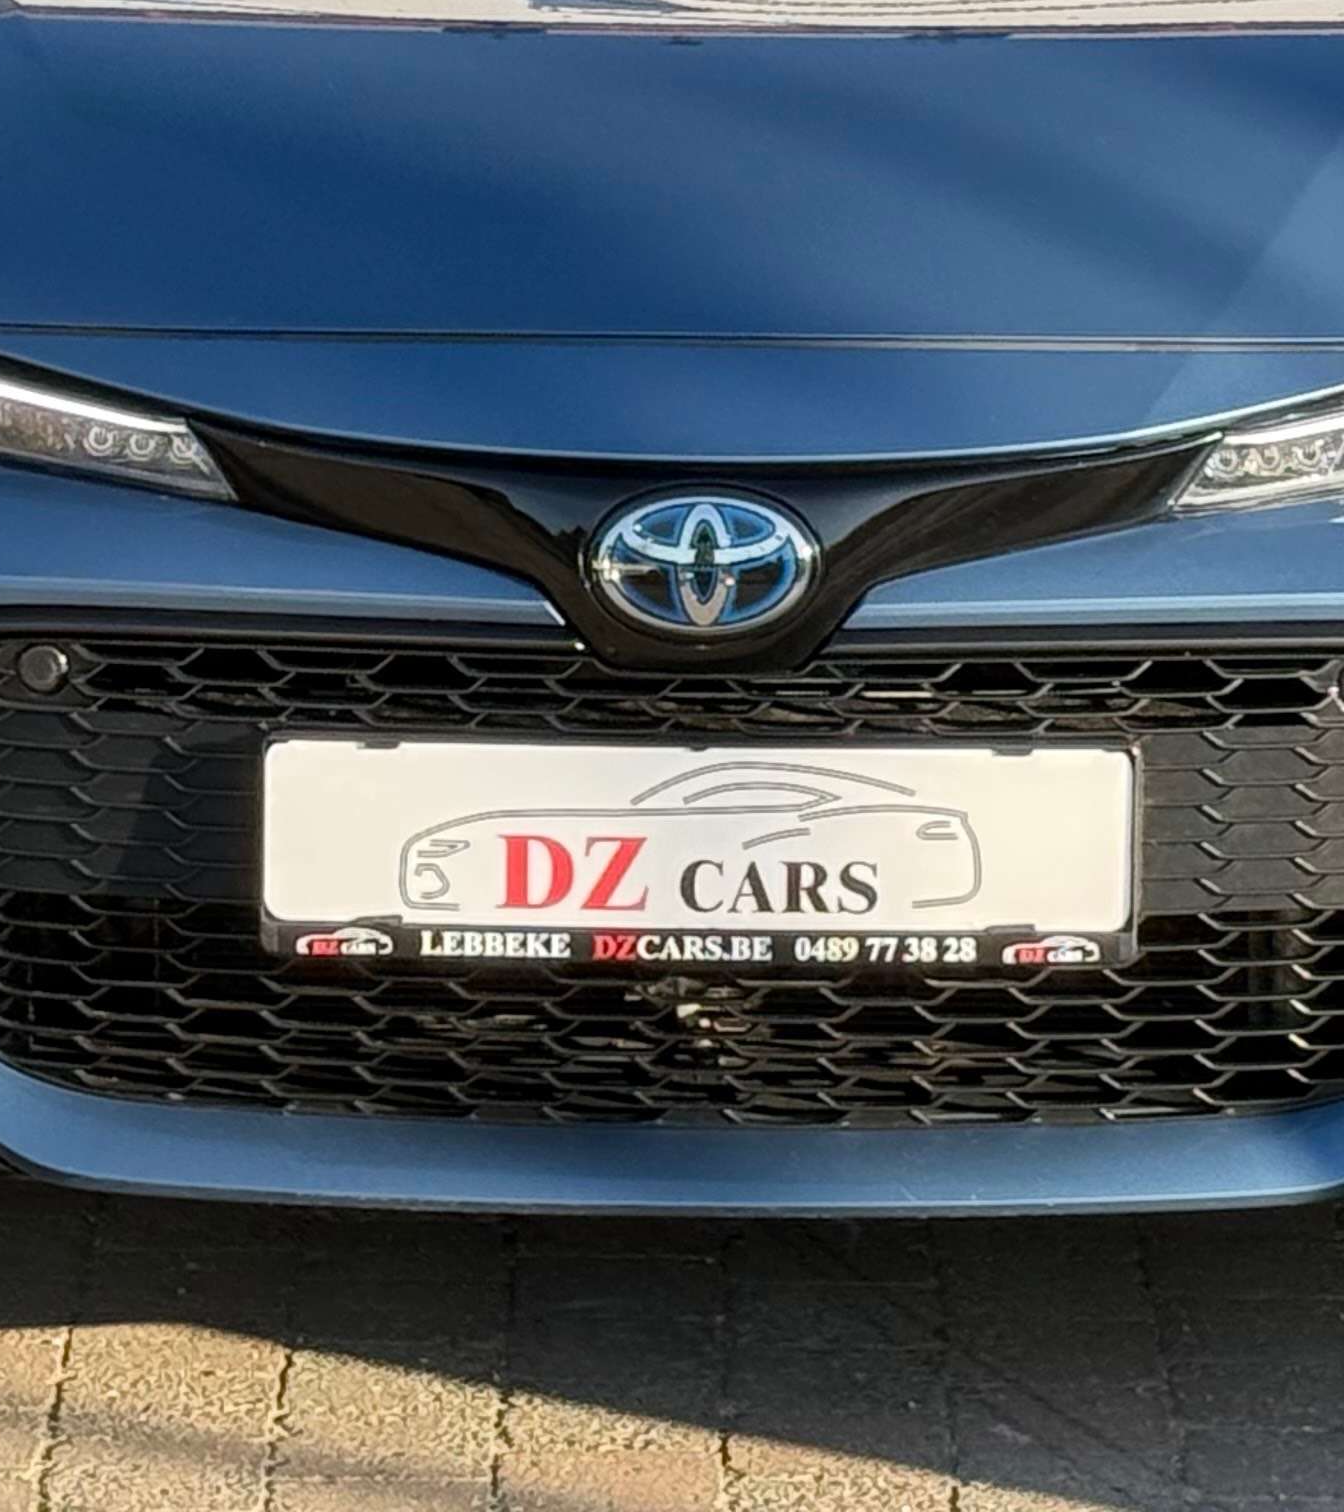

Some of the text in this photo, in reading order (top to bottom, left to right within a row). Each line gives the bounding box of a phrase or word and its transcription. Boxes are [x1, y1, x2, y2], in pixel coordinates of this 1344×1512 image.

[495, 833, 879, 915] DZ CARS
[420, 930, 977, 965] LEBBEKE DZCARS.BE 0489 77 38 28
